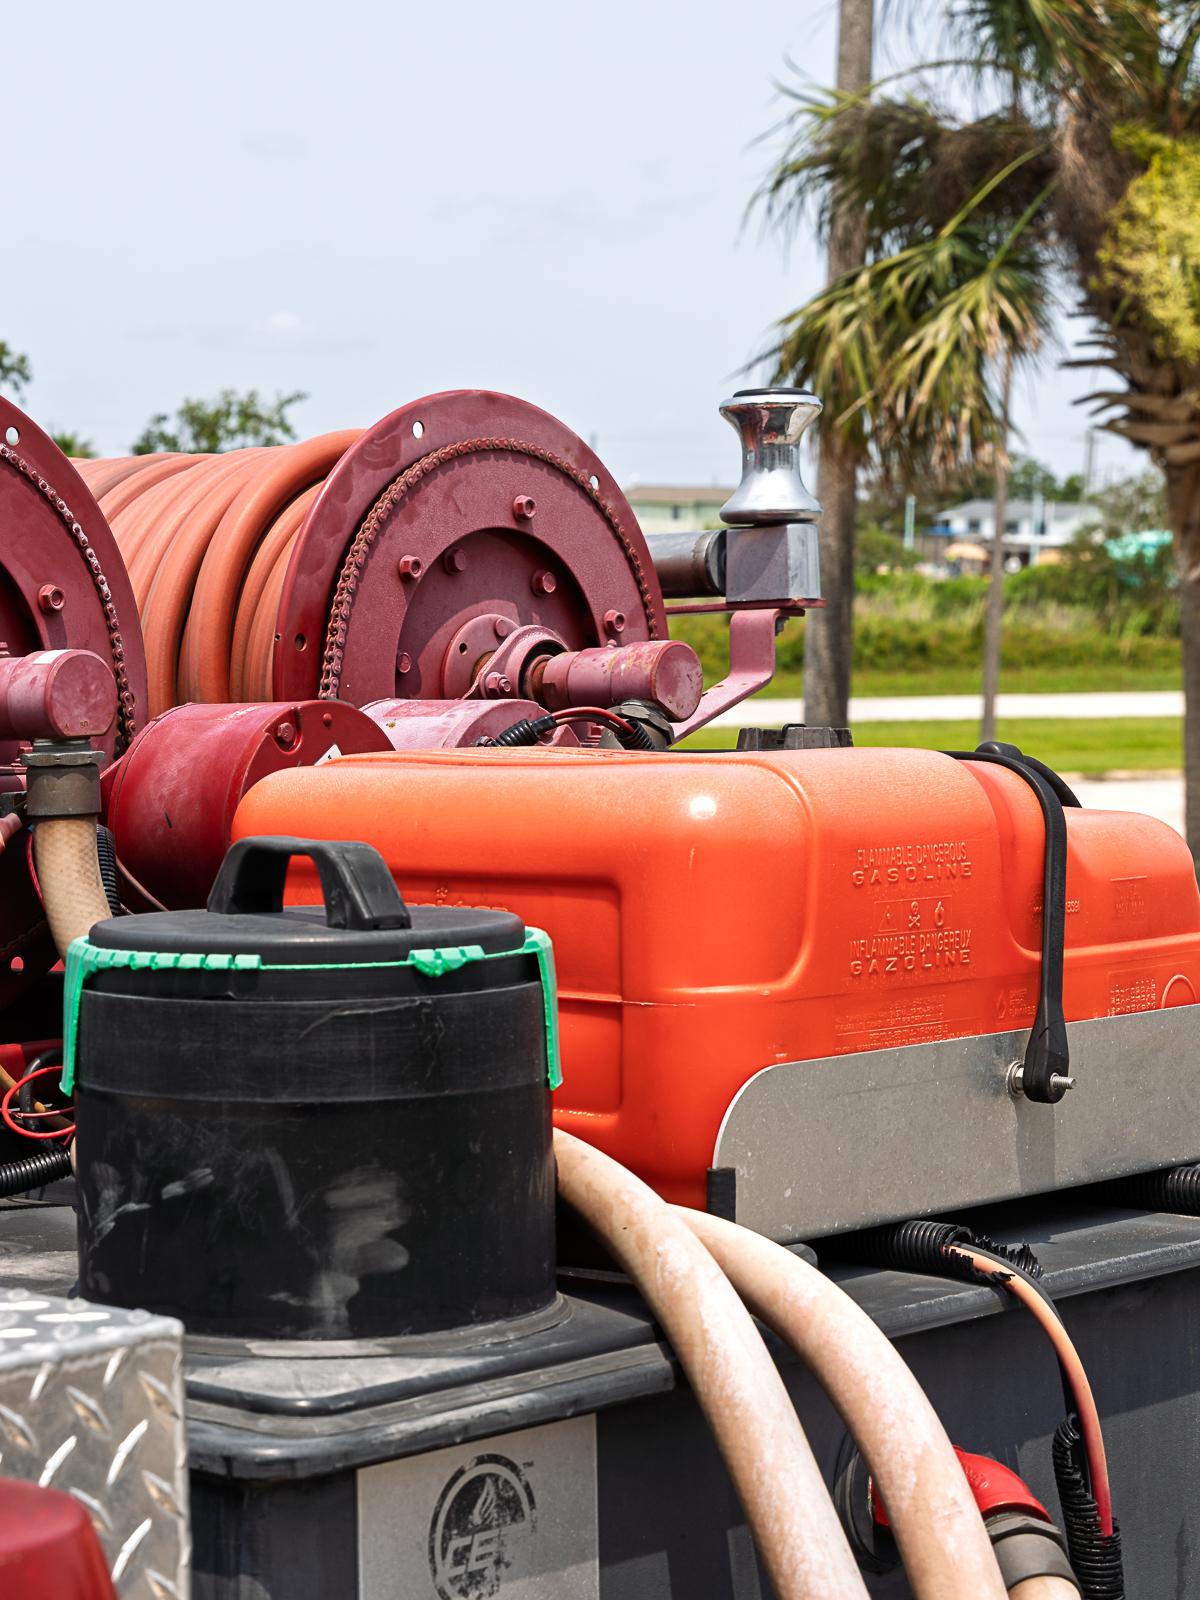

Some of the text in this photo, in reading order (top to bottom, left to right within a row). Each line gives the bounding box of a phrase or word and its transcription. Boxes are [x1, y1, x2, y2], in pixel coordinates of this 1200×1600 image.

[857, 841, 968, 867] FLAMMABLE DANGEROUS
[852, 861, 973, 885] GASOLINE
[849, 929, 973, 957] INFLAMMABLE DANGEREUX
[850, 949, 971, 975] GAZOLINE
